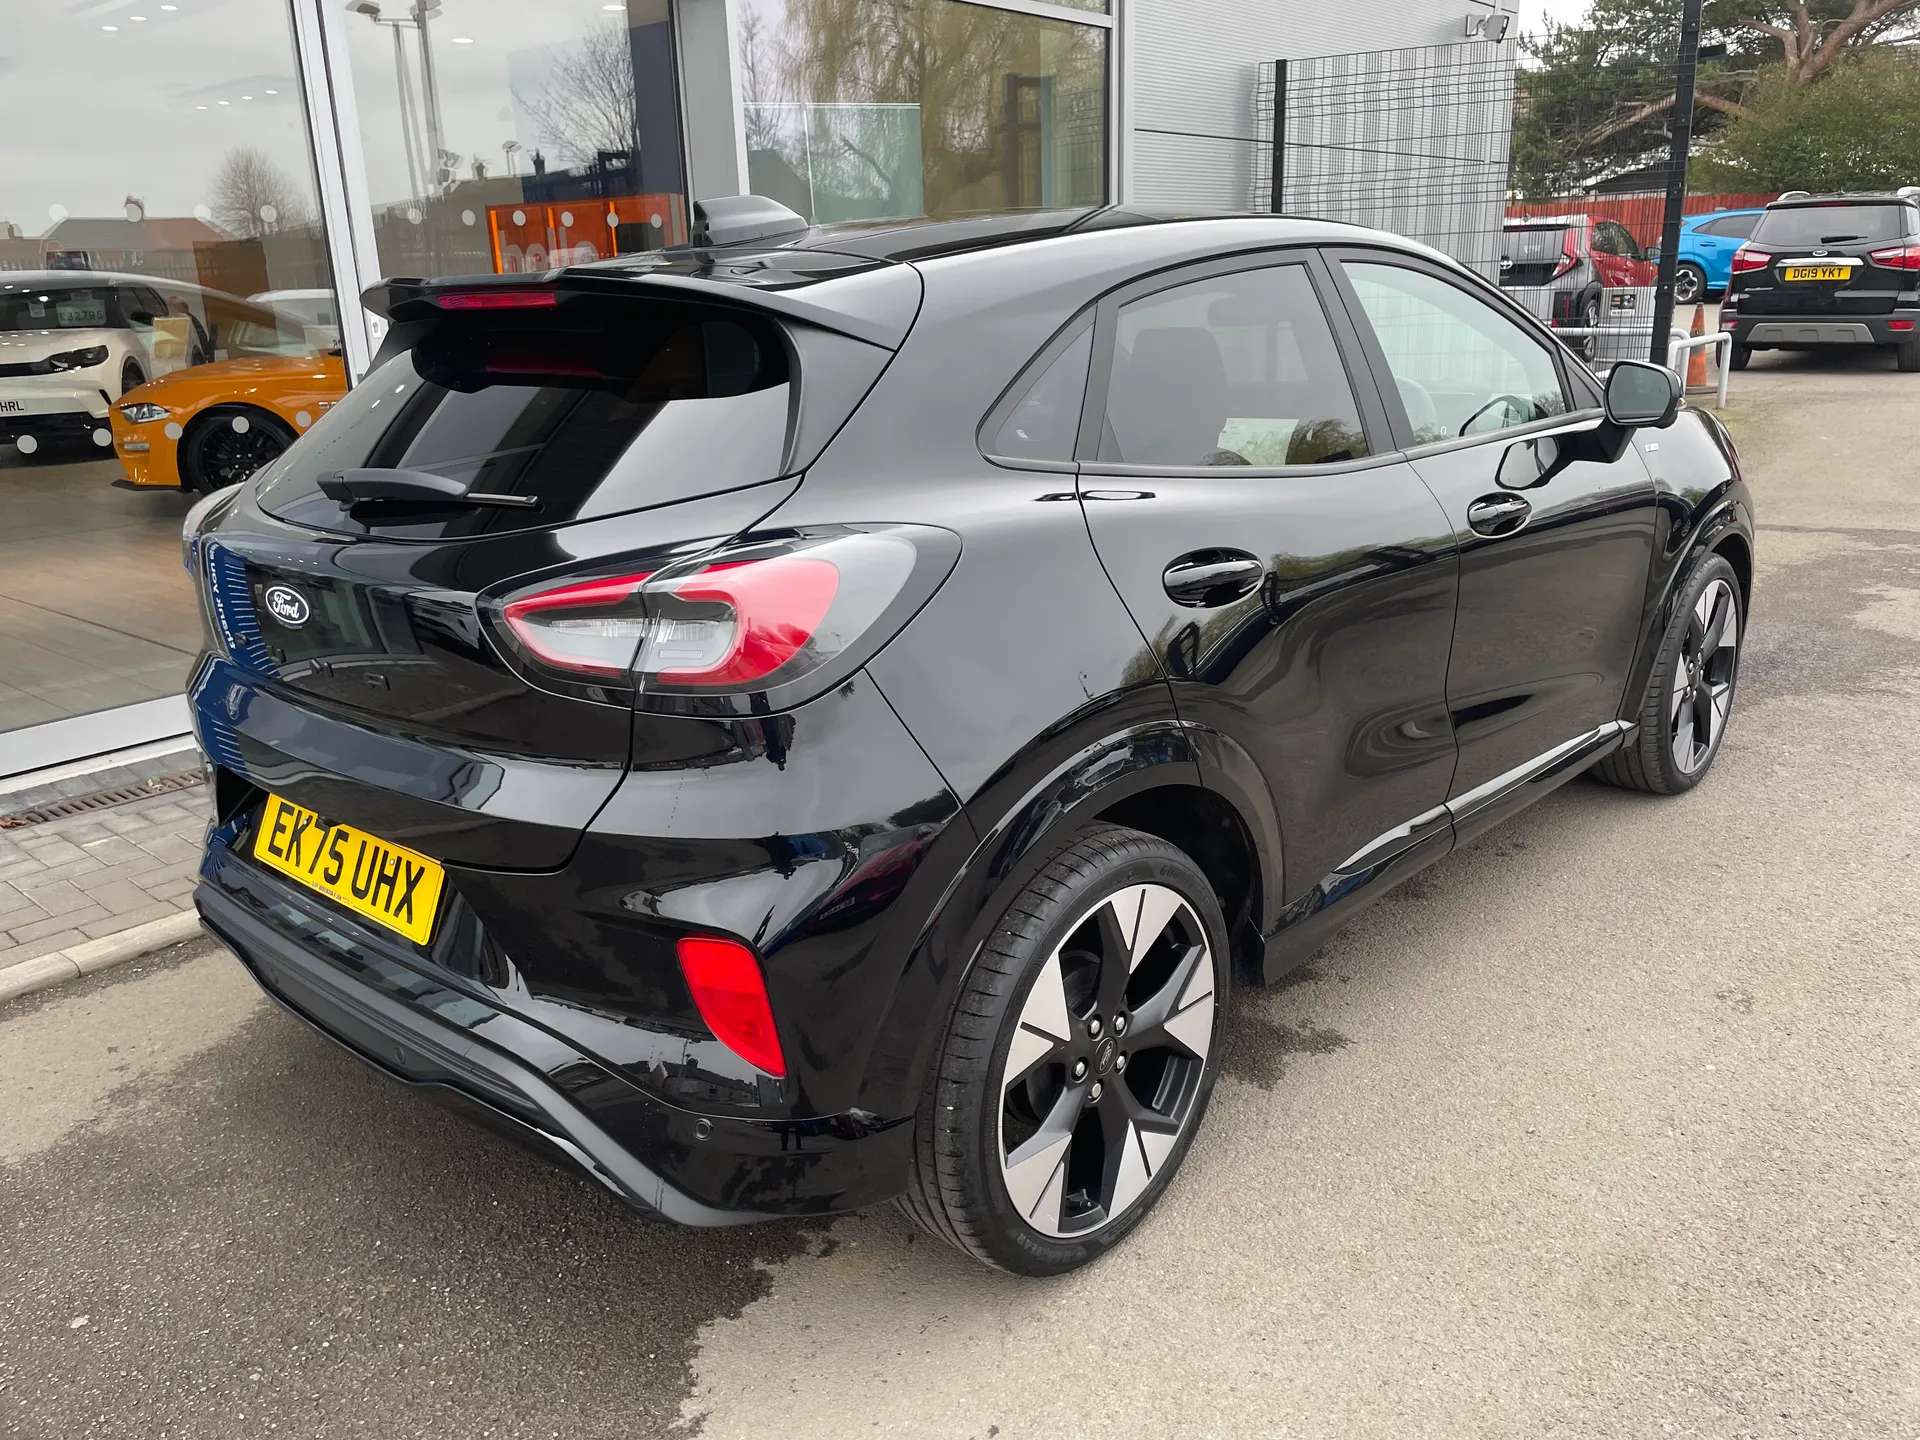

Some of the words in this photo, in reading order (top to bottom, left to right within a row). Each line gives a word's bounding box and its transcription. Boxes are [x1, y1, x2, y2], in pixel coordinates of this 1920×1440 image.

[1793, 268, 1818, 279] DG19
[1821, 268, 1843, 279] YKT
[271, 590, 301, 620] Ford
[267, 802, 350, 885] EK75
[351, 840, 425, 925] UHX
